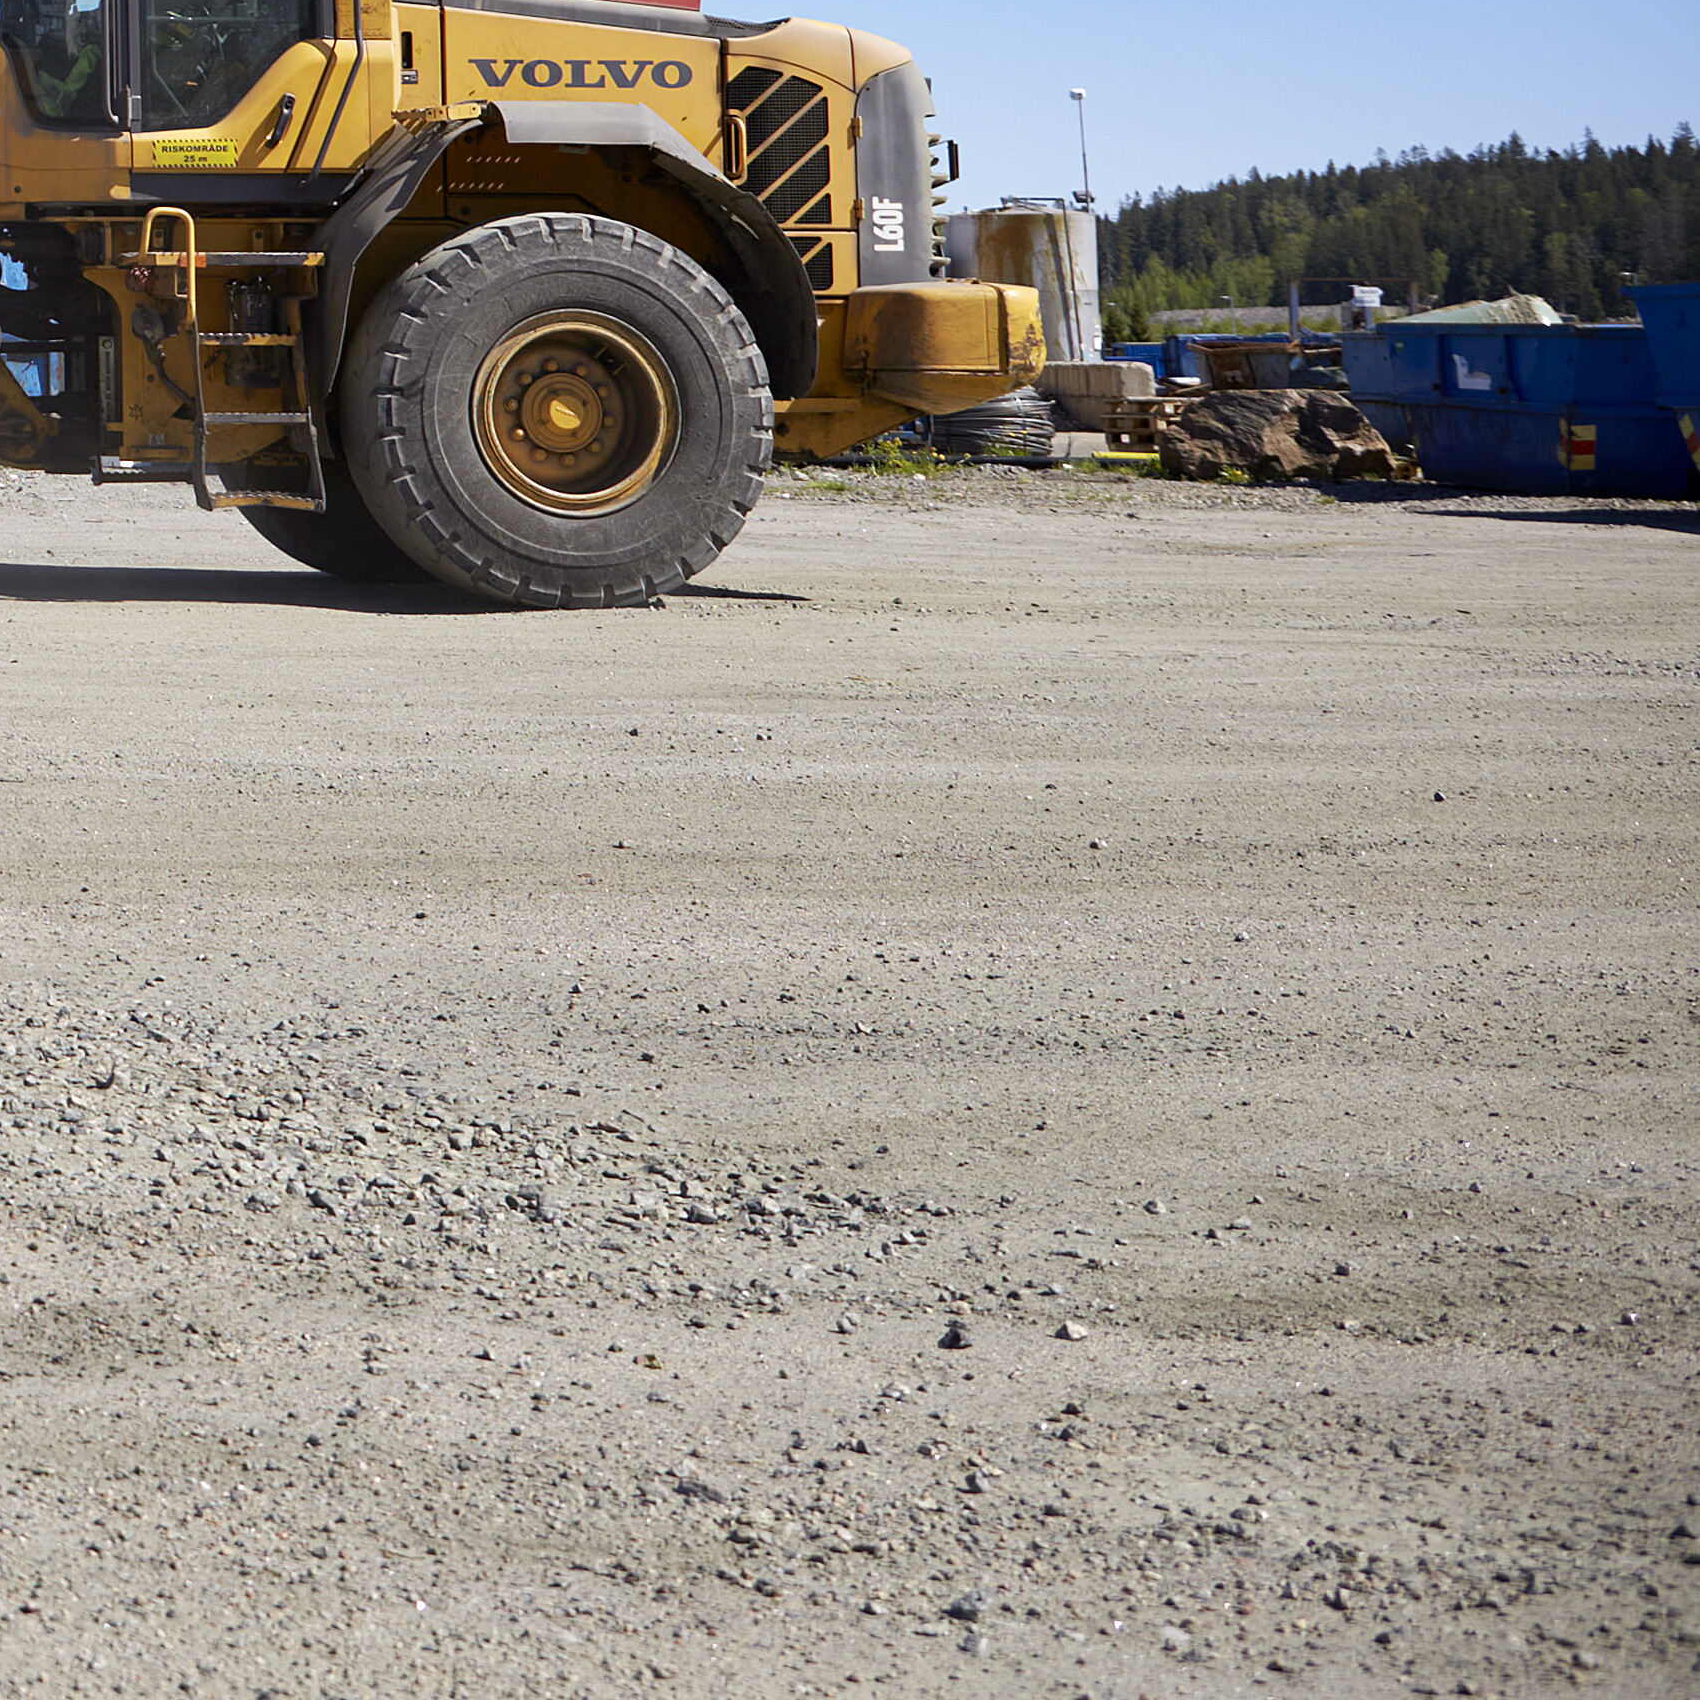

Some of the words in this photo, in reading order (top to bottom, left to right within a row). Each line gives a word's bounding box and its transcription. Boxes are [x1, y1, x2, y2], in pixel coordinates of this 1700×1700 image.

[468, 59, 693, 88] VOLVO
[183, 155, 196, 163] 25
[872, 196, 904, 252] L60F
